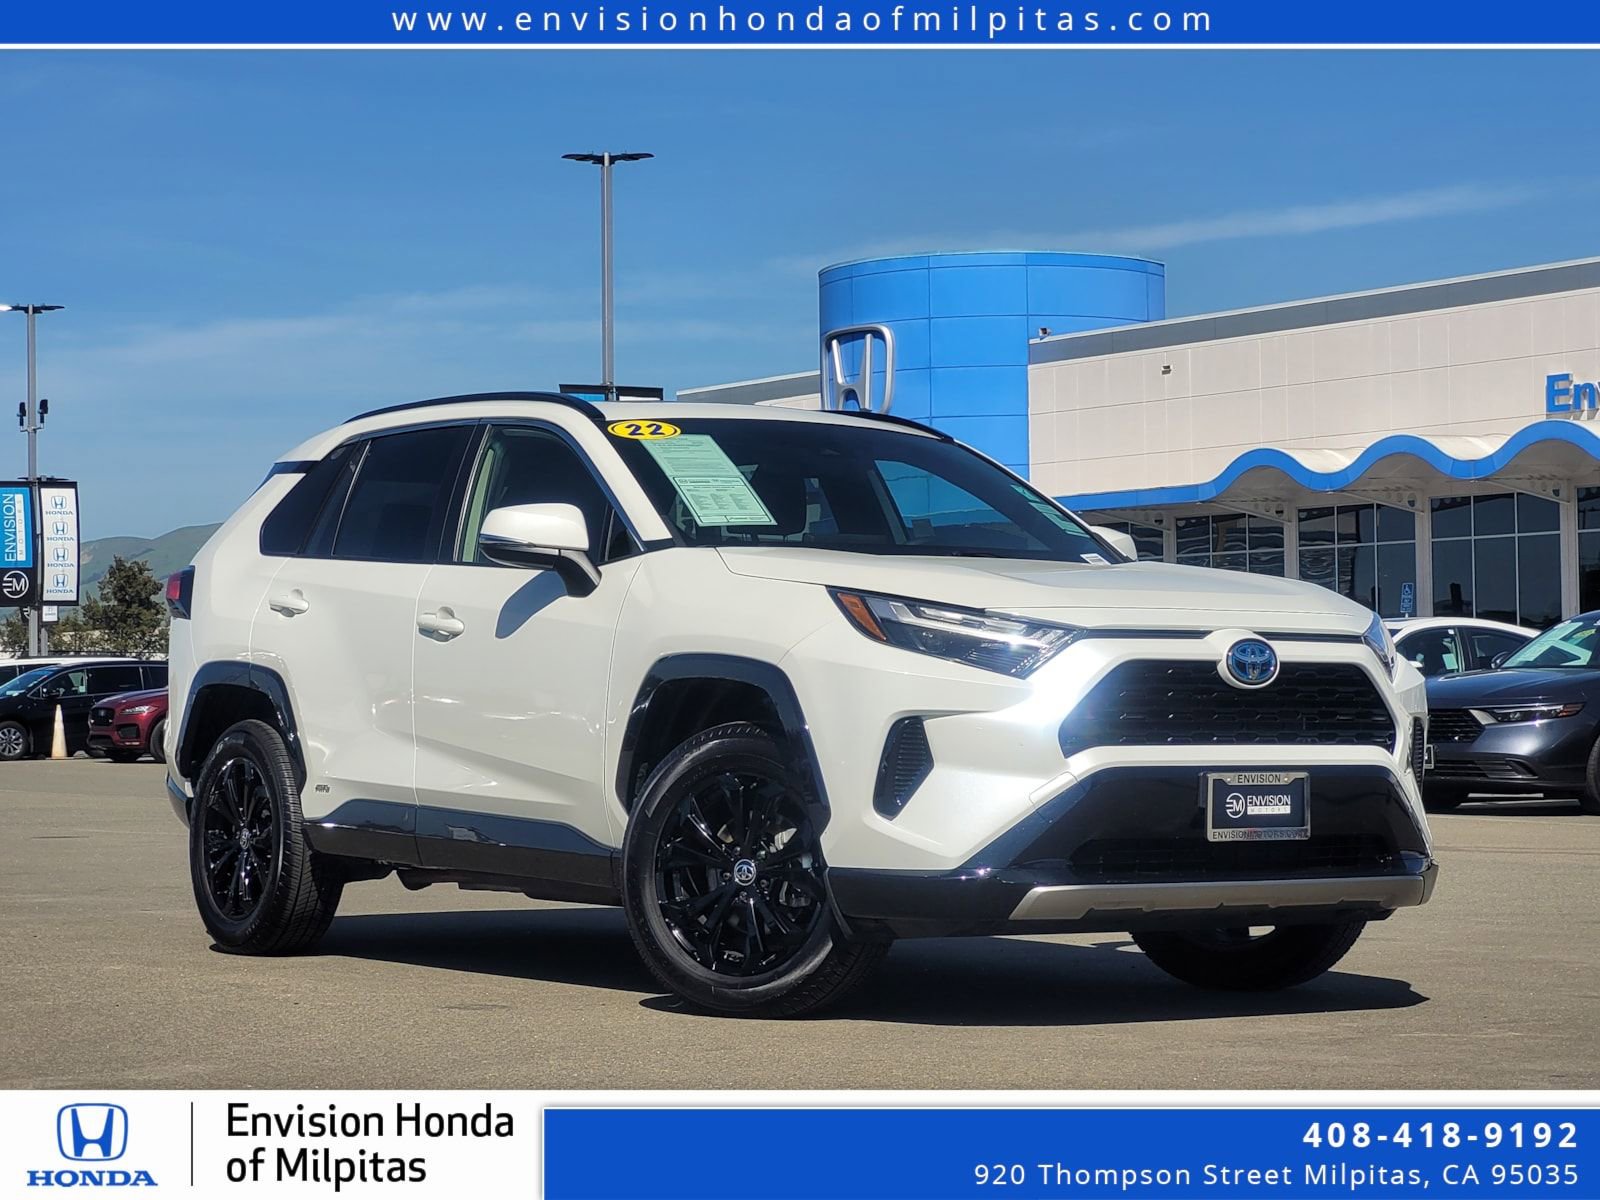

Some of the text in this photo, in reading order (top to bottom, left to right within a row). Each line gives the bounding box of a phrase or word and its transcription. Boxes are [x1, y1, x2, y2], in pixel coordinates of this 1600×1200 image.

[1546, 373, 1600, 413] En
[625, 423, 665, 436] 22
[2, 493, 17, 562] ENVISION
[1237, 774, 1281, 784] ENVISION
[1247, 795, 1291, 806] ENVISION
